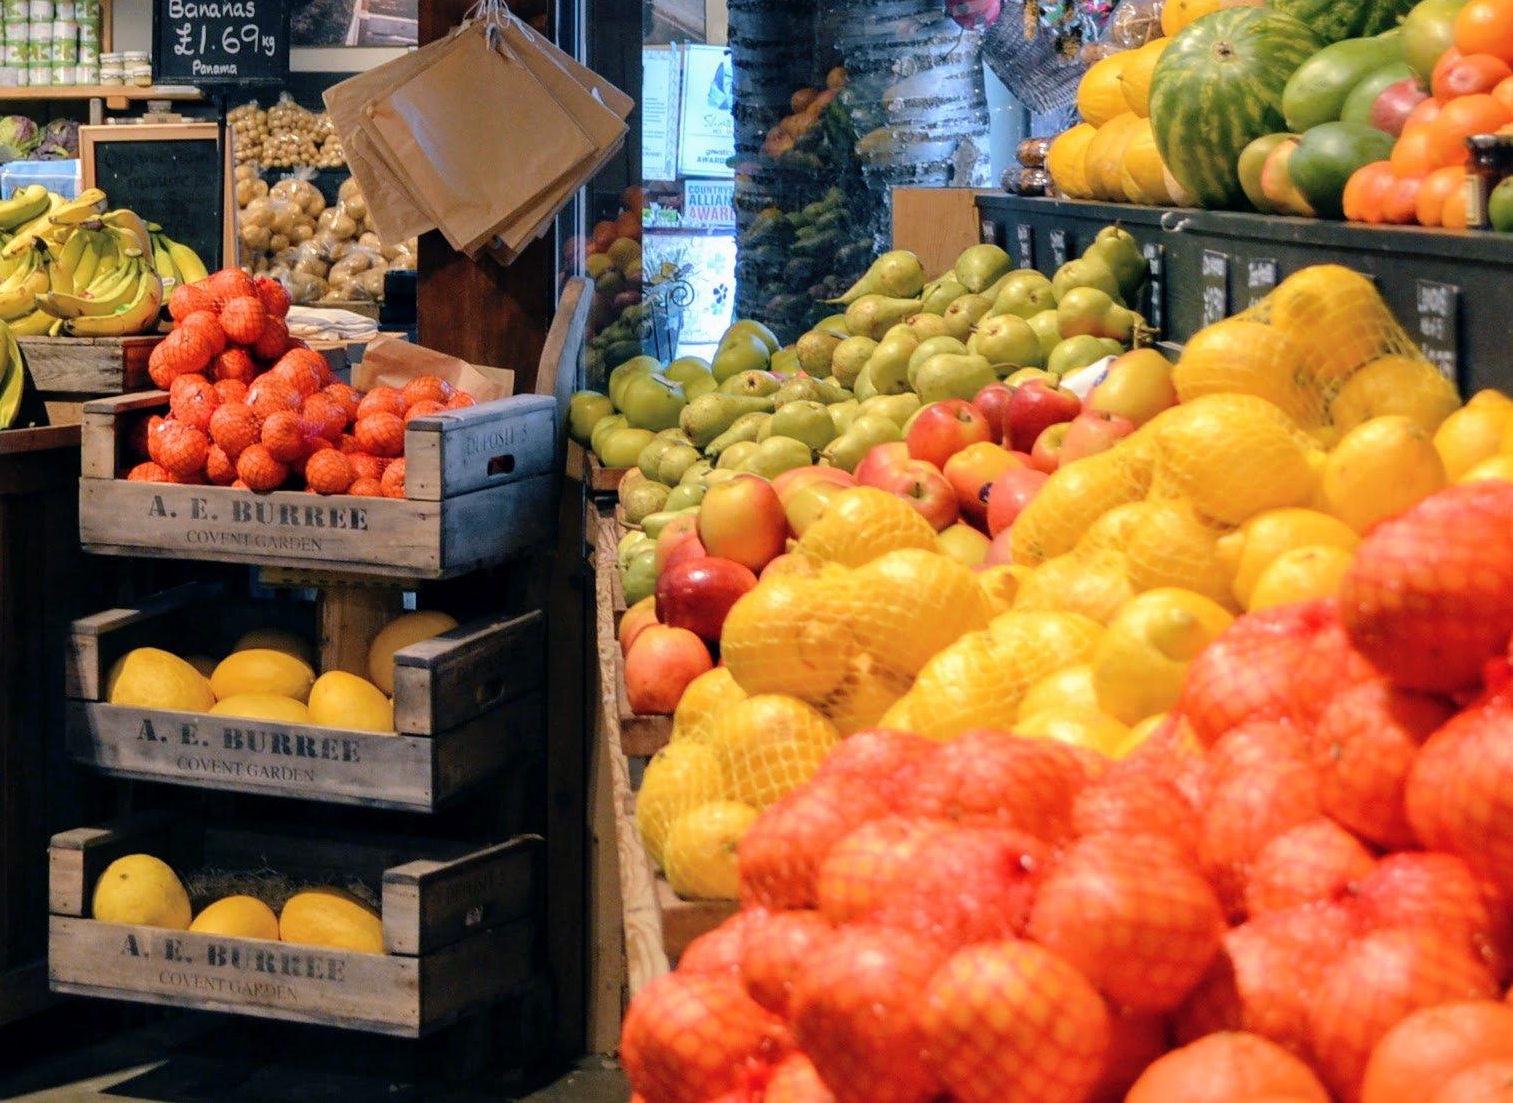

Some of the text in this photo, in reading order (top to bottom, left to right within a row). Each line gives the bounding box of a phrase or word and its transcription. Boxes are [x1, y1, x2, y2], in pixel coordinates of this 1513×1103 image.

[192, 59, 237, 75] Panama
[148, 495, 369, 531] A. E. BURREE
[186, 529, 323, 551] COVENT GARDEN
[137, 719, 361, 762] A. E. BURREE
[177, 755, 314, 782] COVENT GARDEN
[120, 934, 346, 982] A. E. BURREE
[159, 970, 298, 1001] COVENT GARDEN
